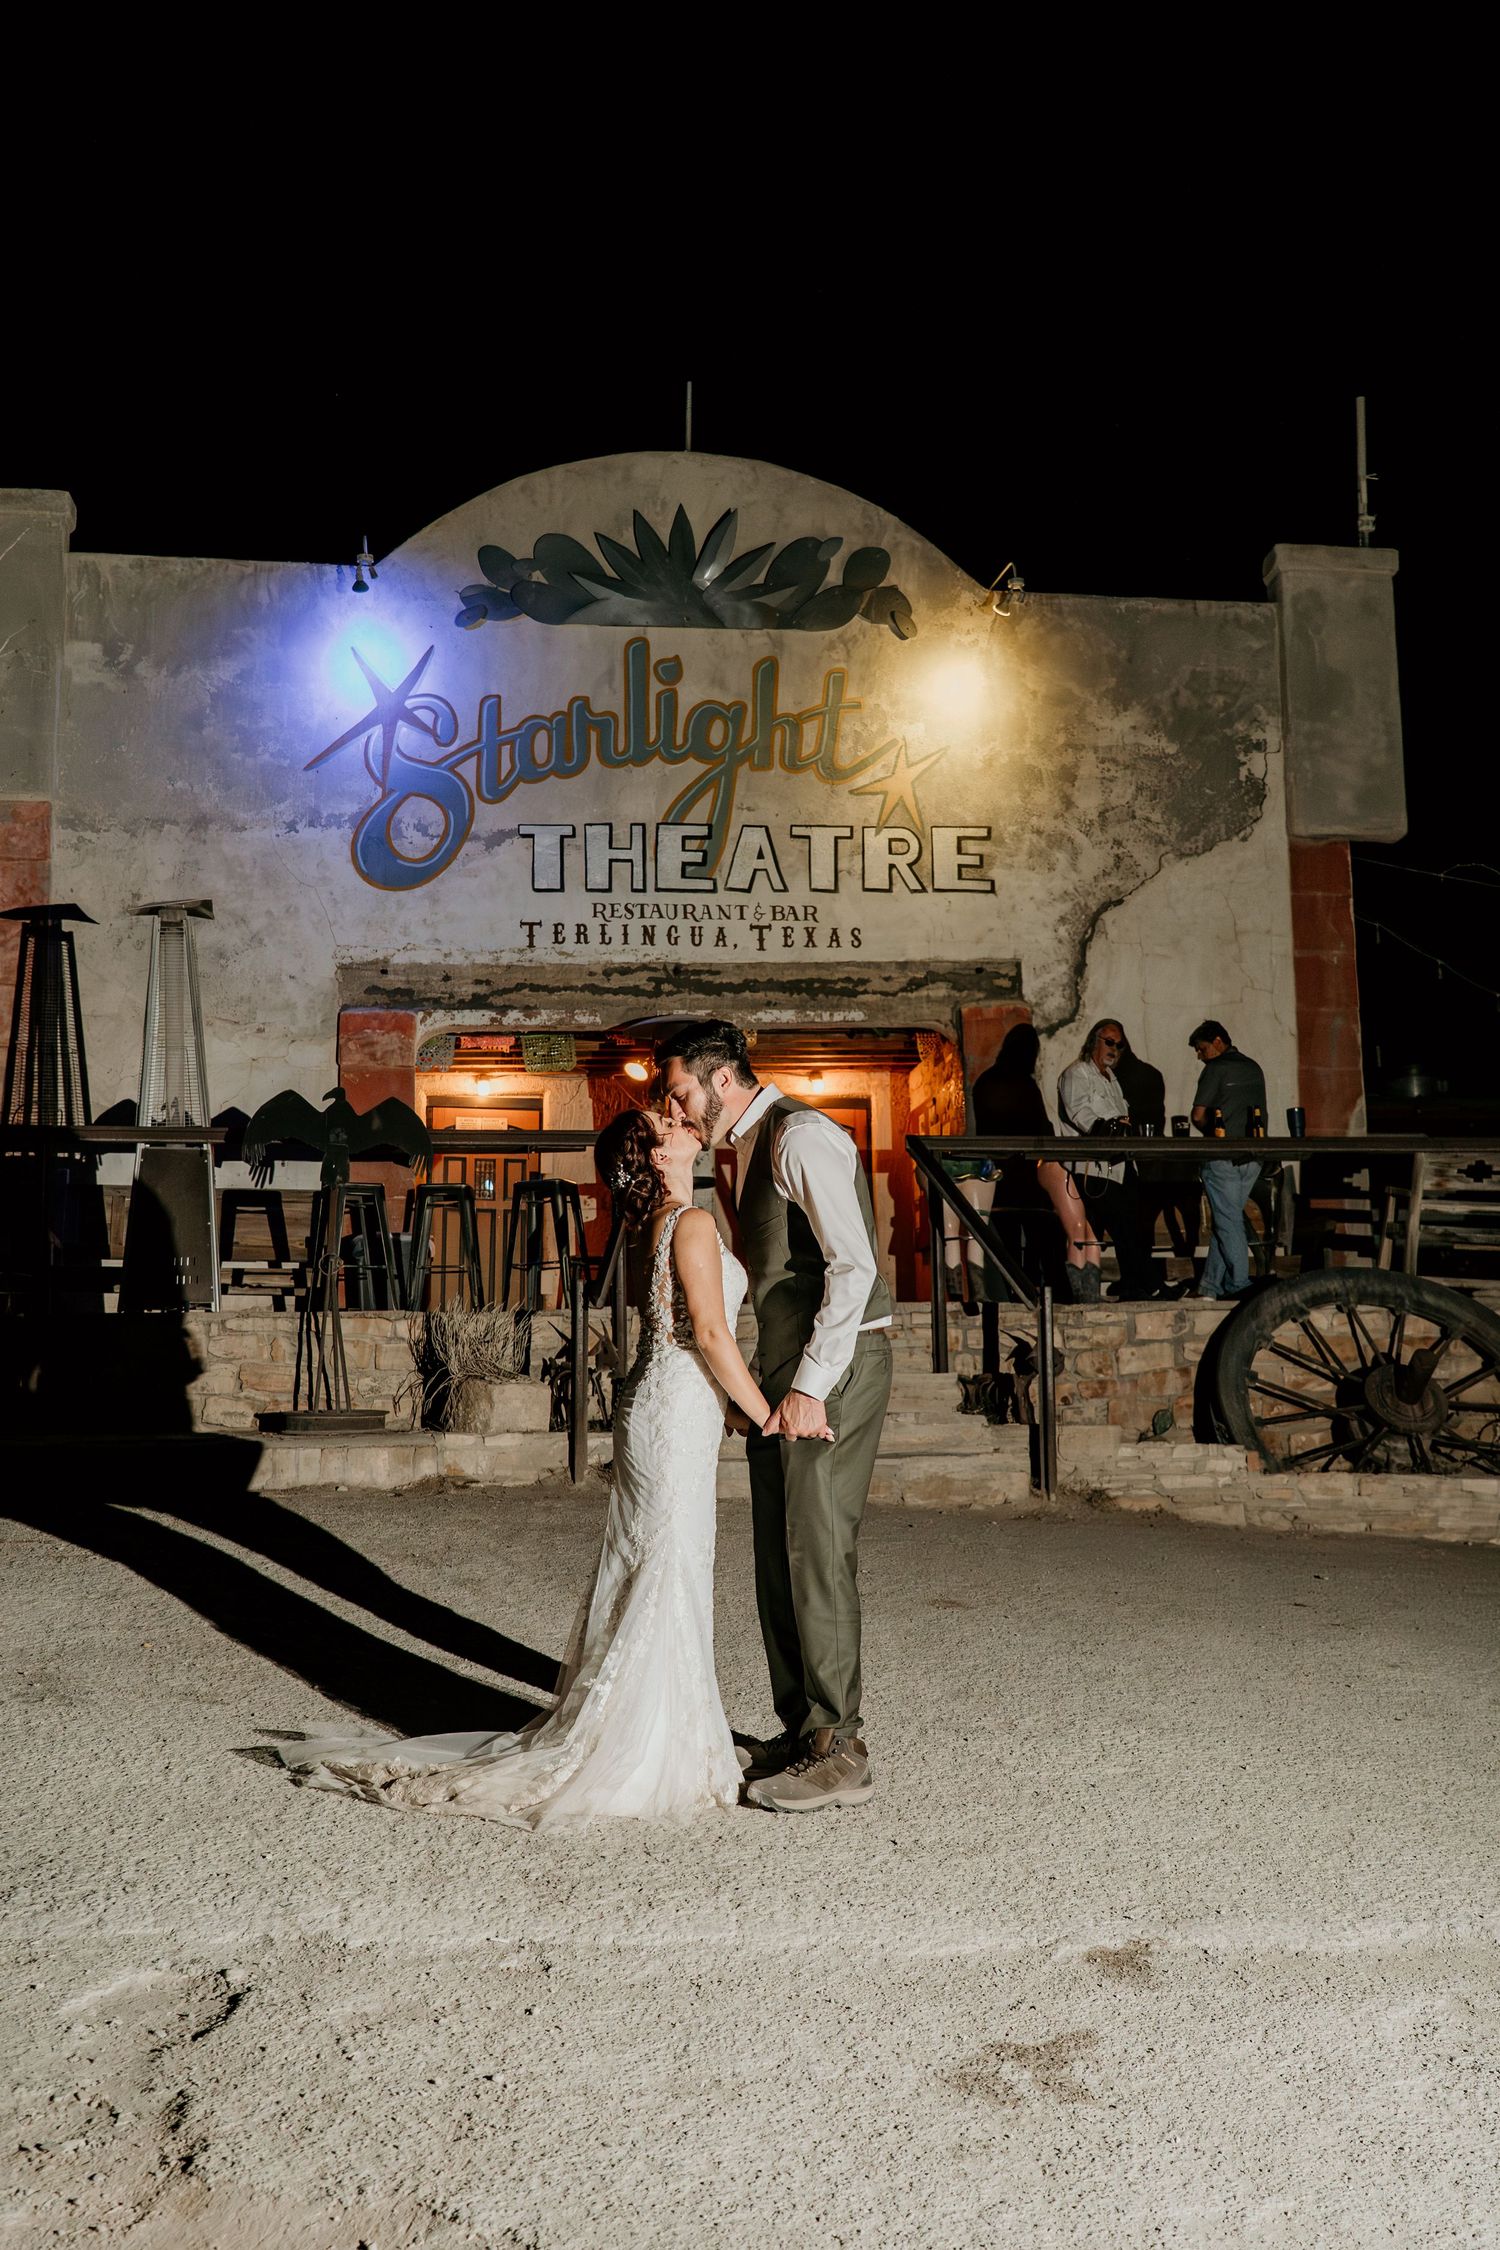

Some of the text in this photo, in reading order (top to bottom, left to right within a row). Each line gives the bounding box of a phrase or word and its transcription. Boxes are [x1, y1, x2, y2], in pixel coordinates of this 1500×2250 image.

[350, 636, 902, 891] Starlight
[518, 823, 997, 894] THEATRE
[519, 920, 863, 951] TERLINGUA, TEXAS
[592, 902, 820, 922] RESTAURANT & BAR
